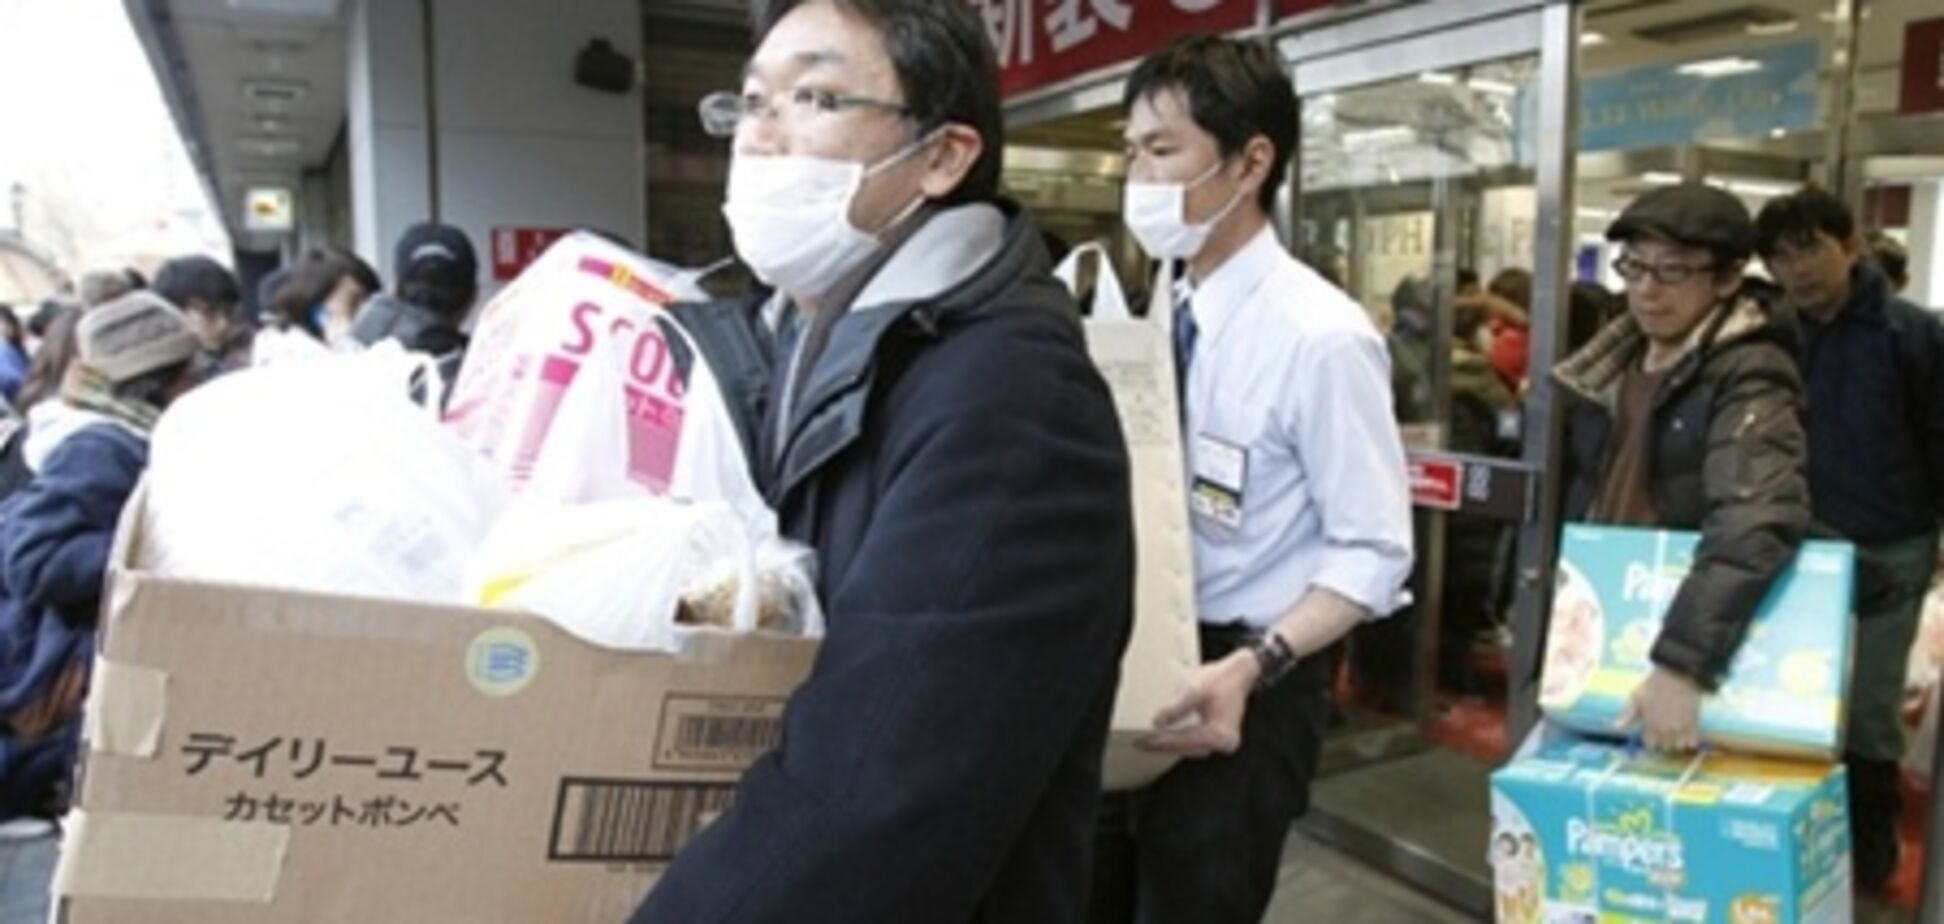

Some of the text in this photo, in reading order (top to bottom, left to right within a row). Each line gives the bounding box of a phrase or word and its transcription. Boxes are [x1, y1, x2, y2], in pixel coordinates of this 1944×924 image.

[181, 731, 508, 788] デイリーユース
[1567, 816, 1684, 875] Pampers
